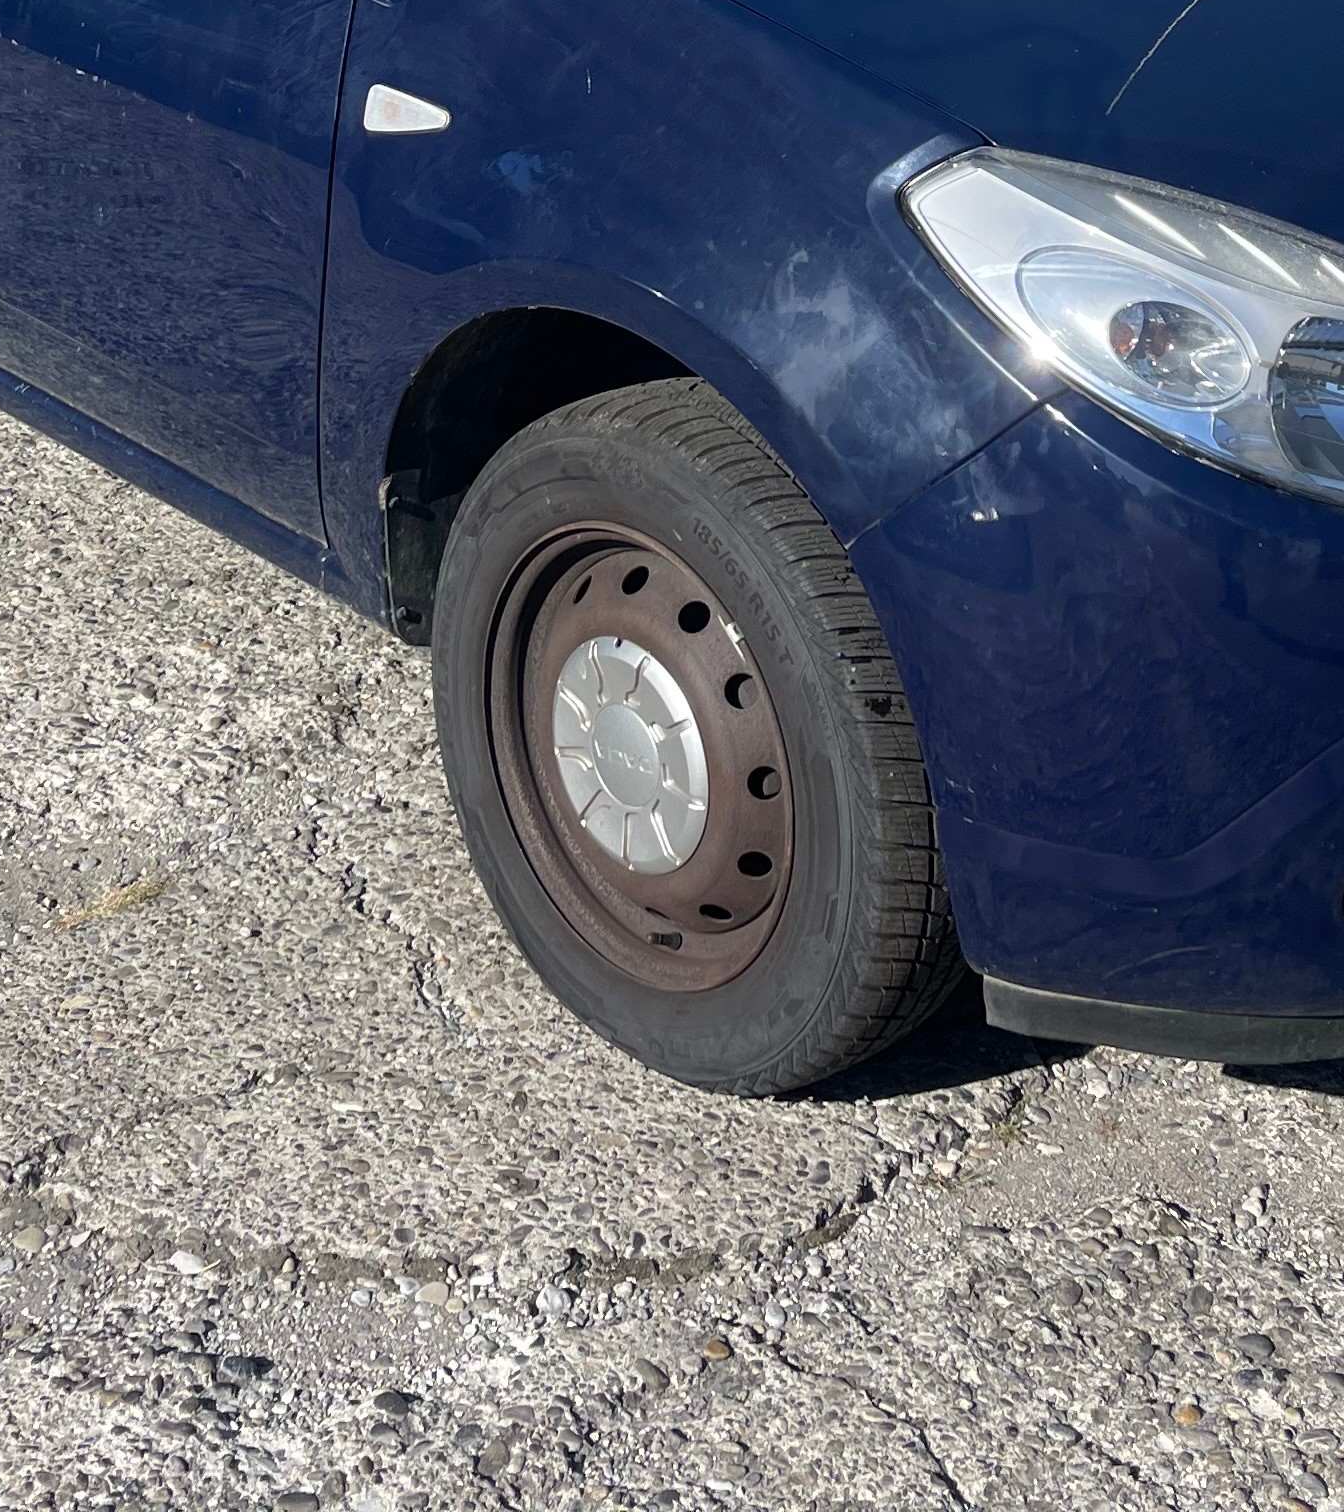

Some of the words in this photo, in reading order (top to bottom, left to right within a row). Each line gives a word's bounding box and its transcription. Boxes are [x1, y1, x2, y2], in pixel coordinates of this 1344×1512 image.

[691, 517, 750, 589] 185/65
[749, 592, 783, 642] R15
[777, 648, 794, 667] T
